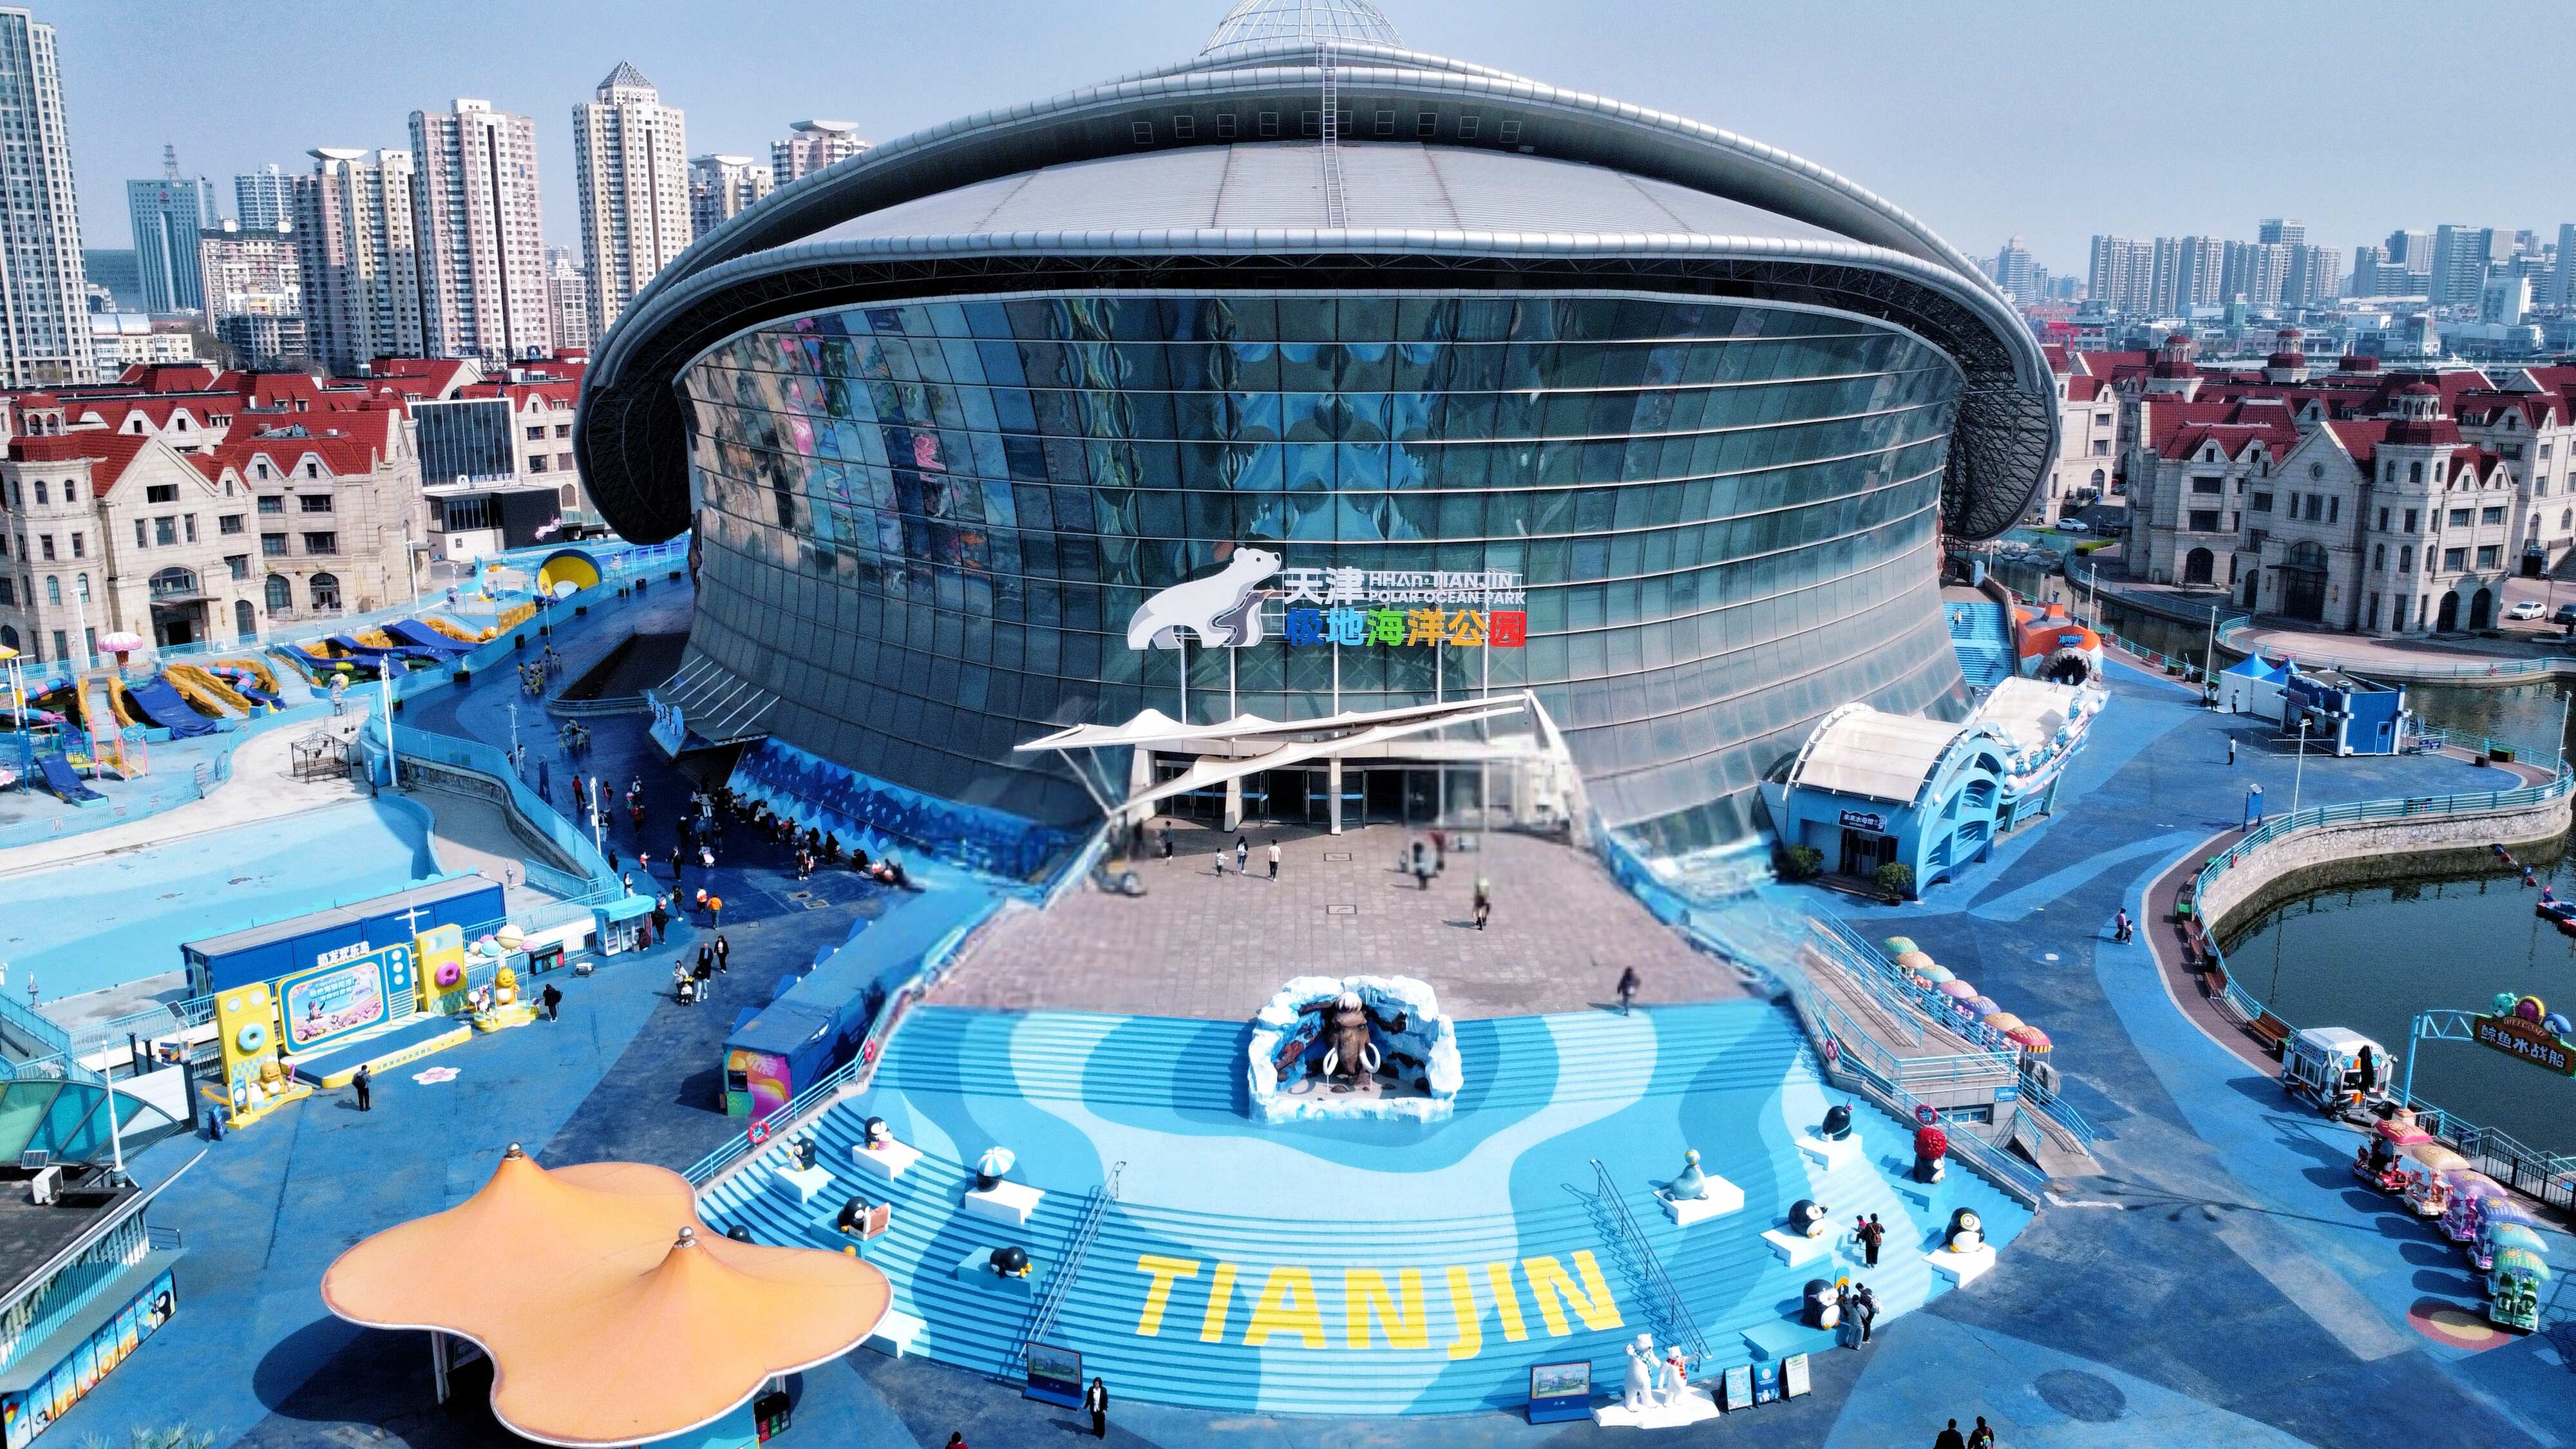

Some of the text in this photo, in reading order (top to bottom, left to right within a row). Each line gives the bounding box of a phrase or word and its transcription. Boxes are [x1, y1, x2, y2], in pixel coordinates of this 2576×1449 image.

[1284, 565, 1365, 605] 天津
[1368, 589, 1526, 605] POLAR OCEAN PARK
[1285, 607, 1526, 648] 极地海洋公园
[2480, 1024, 2566, 1068] 鲸鱼水战船
[1135, 1249, 1625, 1360] TIANJIN
